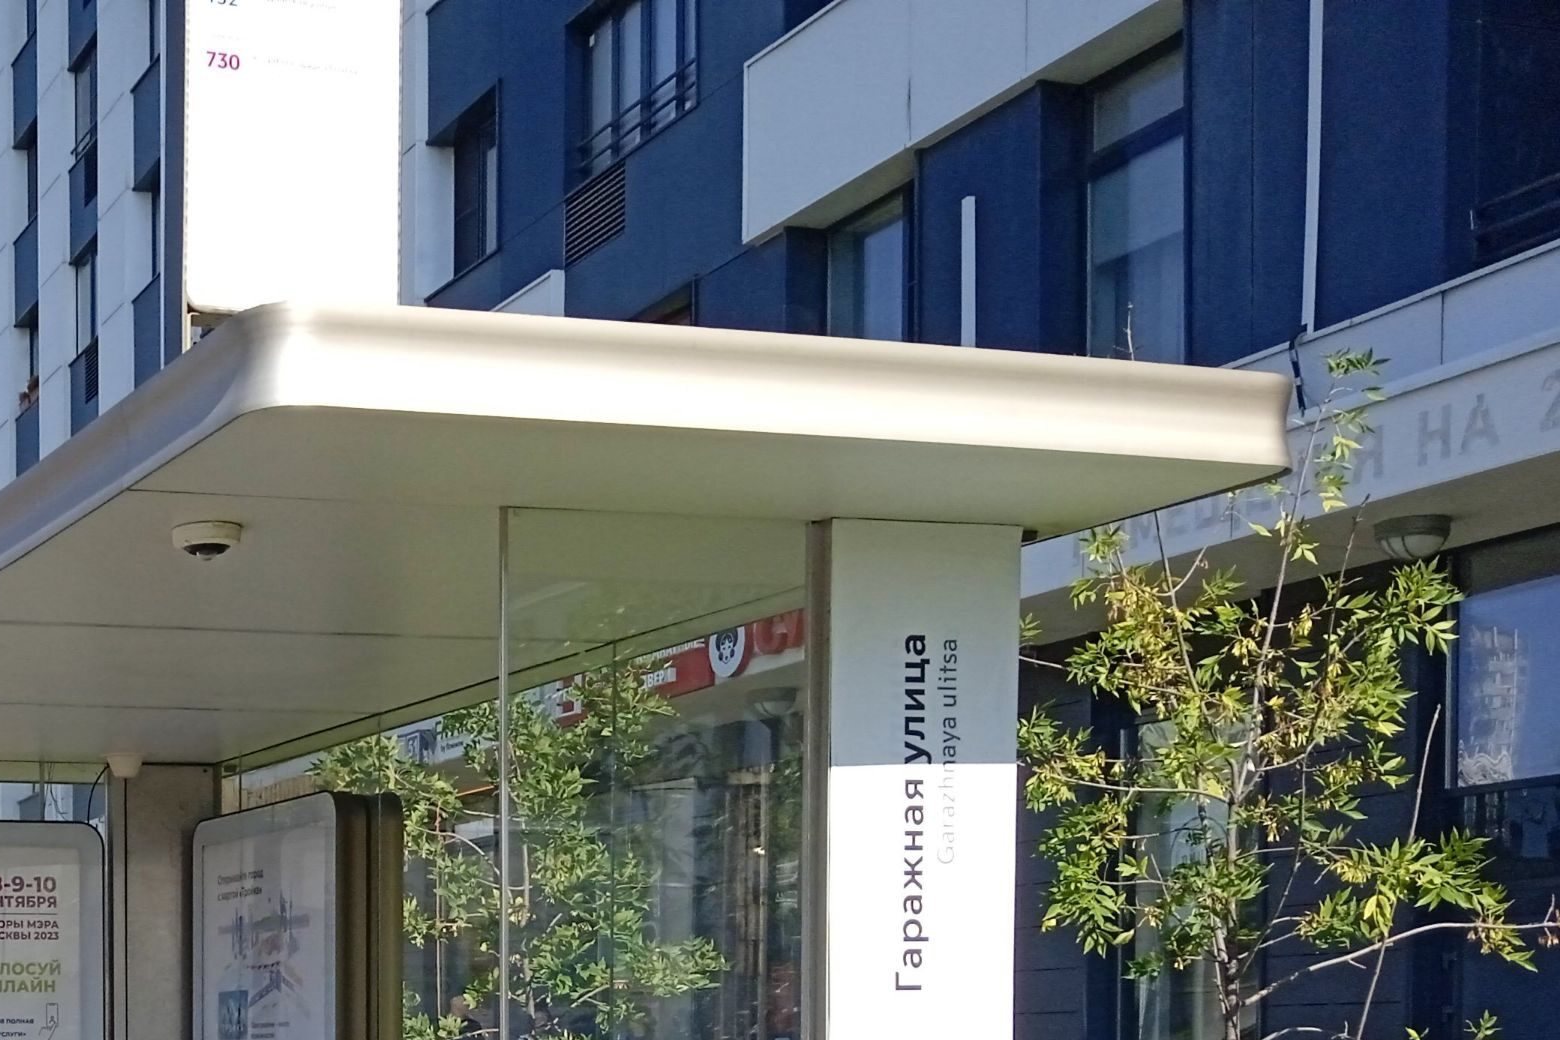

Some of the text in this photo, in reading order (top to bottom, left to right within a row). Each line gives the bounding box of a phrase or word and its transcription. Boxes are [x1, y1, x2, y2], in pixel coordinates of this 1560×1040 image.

[206, 51, 240, 70] 730
[937, 639, 961, 864] Garazhnaya ulitsa
[895, 634, 932, 991] Гаражная улица
[27, 920, 59, 929] МЭРА
[34, 931, 59, 940] 2023
